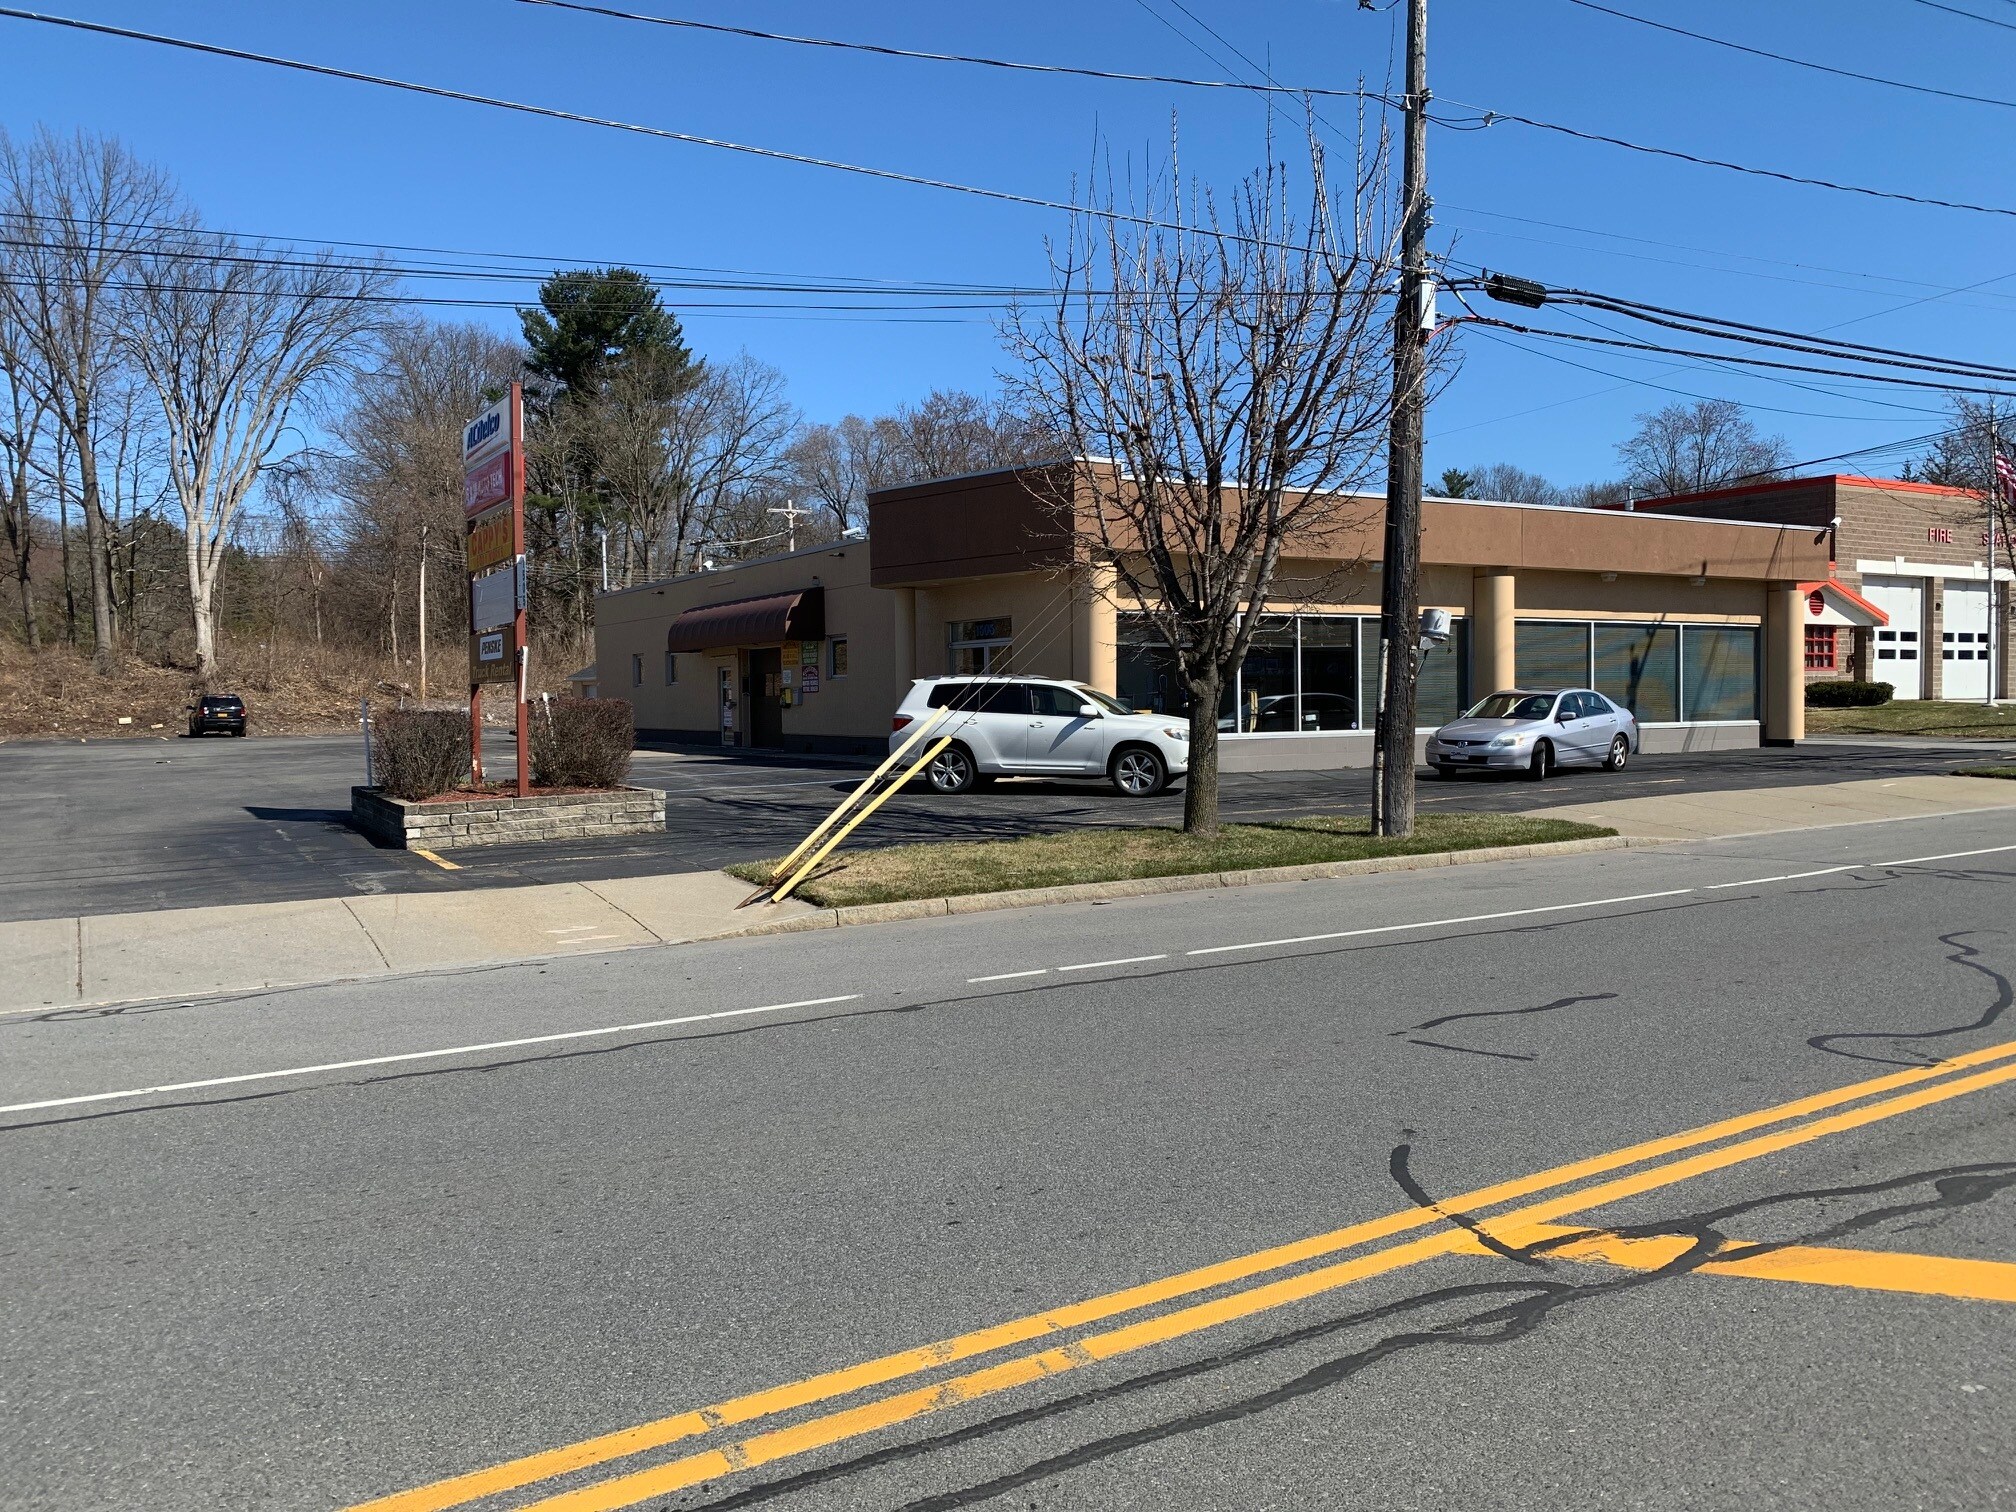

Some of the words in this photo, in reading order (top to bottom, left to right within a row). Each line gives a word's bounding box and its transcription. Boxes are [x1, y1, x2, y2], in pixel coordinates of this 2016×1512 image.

[467, 413, 500, 451] ACDelco
[471, 519, 508, 556] CAPPY'S
[1928, 528, 1953, 543] FIRE
[482, 639, 501, 655] PENSKE
[472, 664, 489, 679] Truck
[490, 662, 512, 677] Rental
